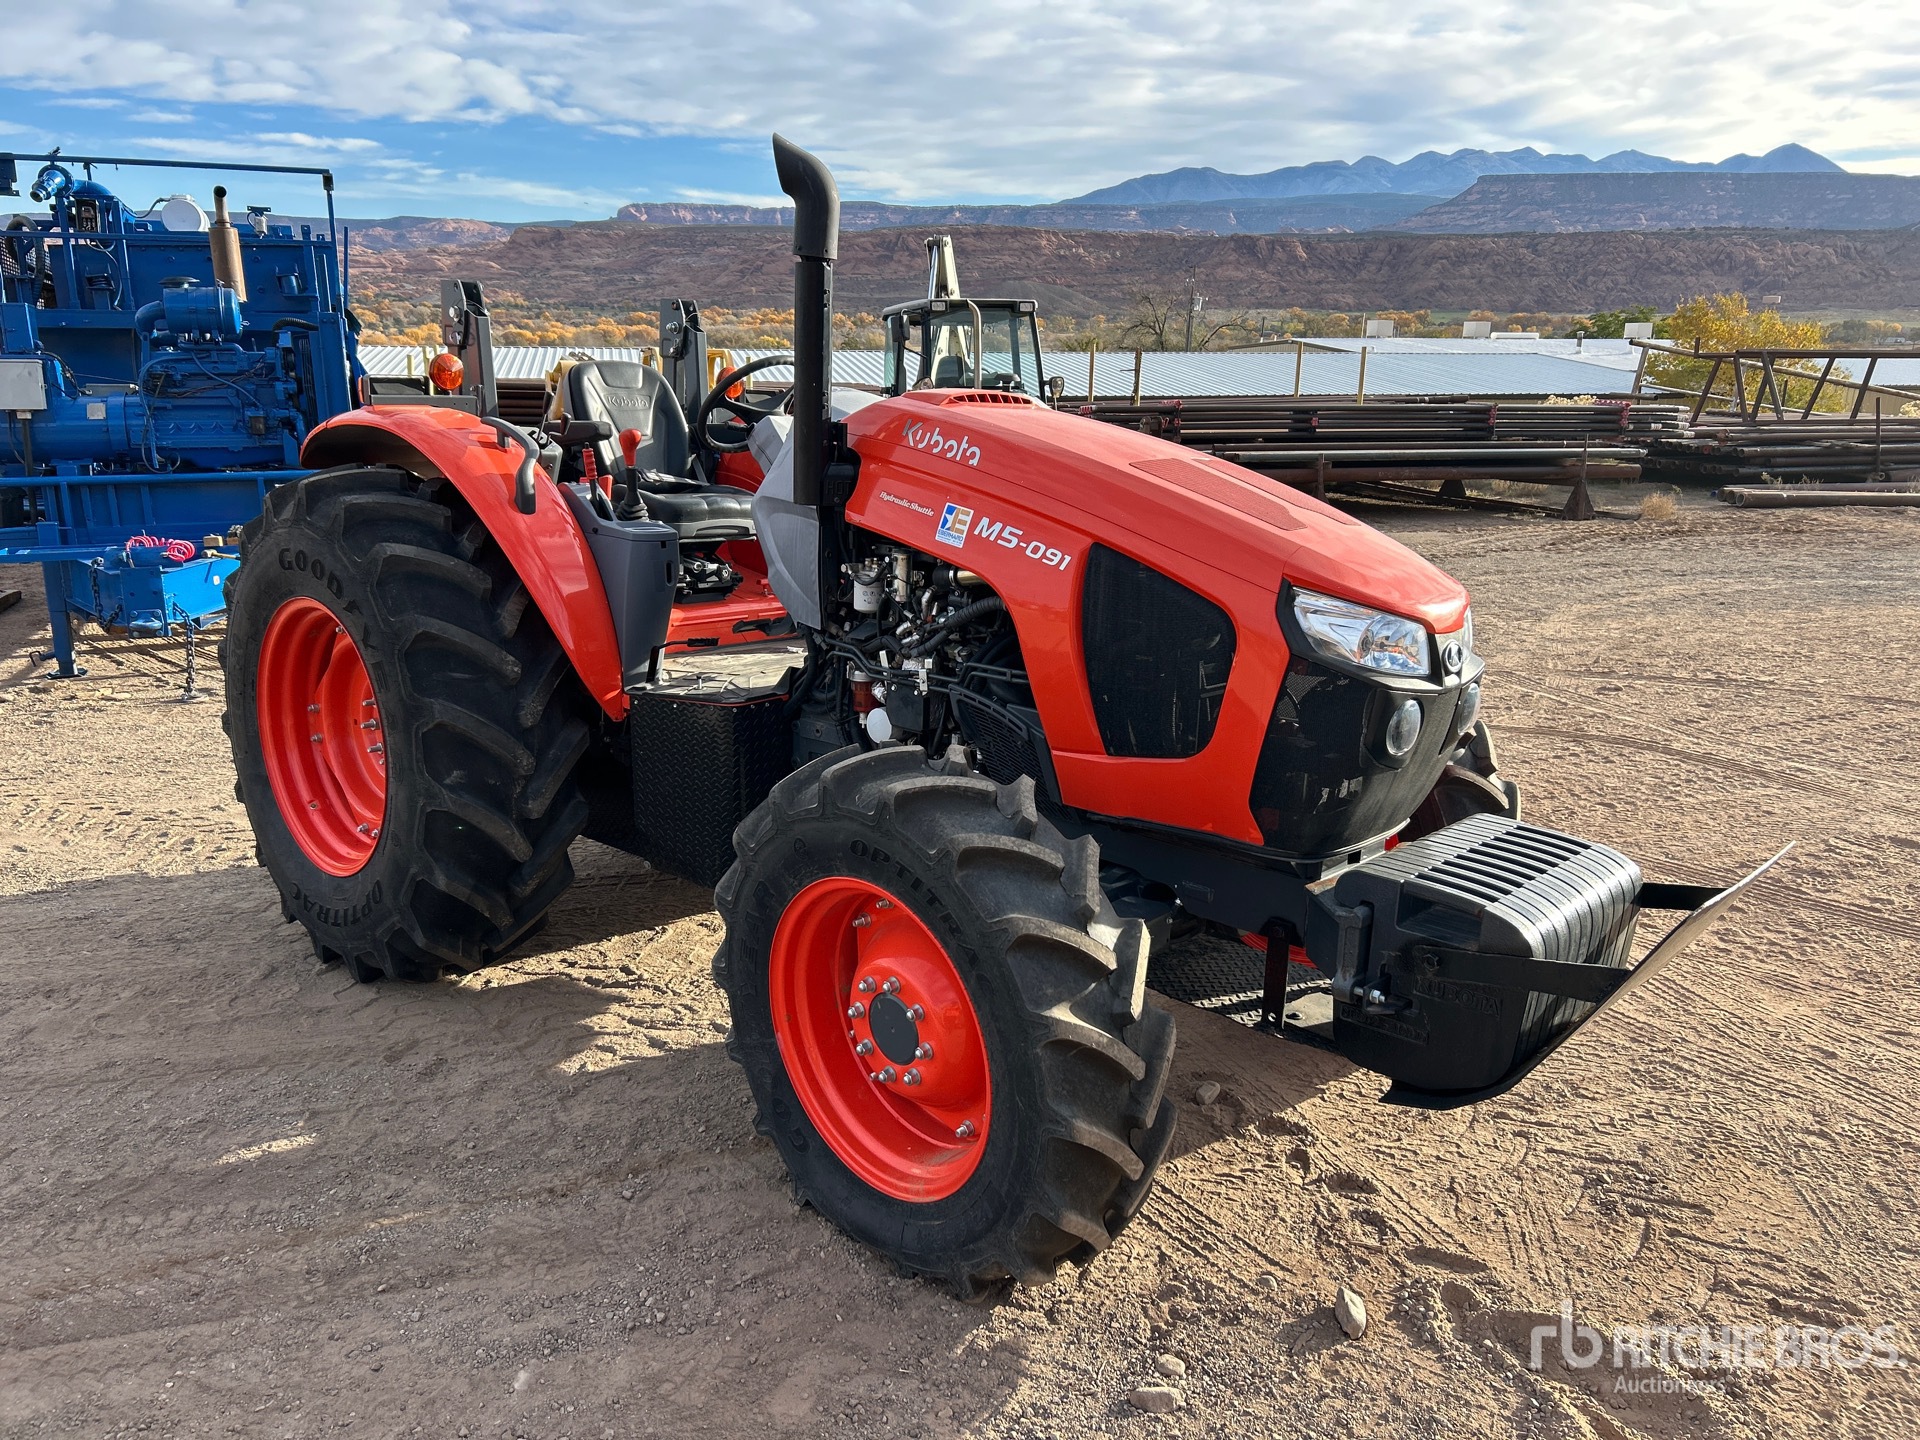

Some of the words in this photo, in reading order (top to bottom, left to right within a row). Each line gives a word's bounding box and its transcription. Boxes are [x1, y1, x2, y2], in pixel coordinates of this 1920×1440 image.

[902, 418, 981, 467] Kubota
[825, 479, 853, 496] HOT
[879, 491, 910, 509] Hydraulic
[910, 502, 935, 517] Shuttle
[973, 516, 1072, 571] M5-091
[289, 878, 384, 928] OPTITRAC
